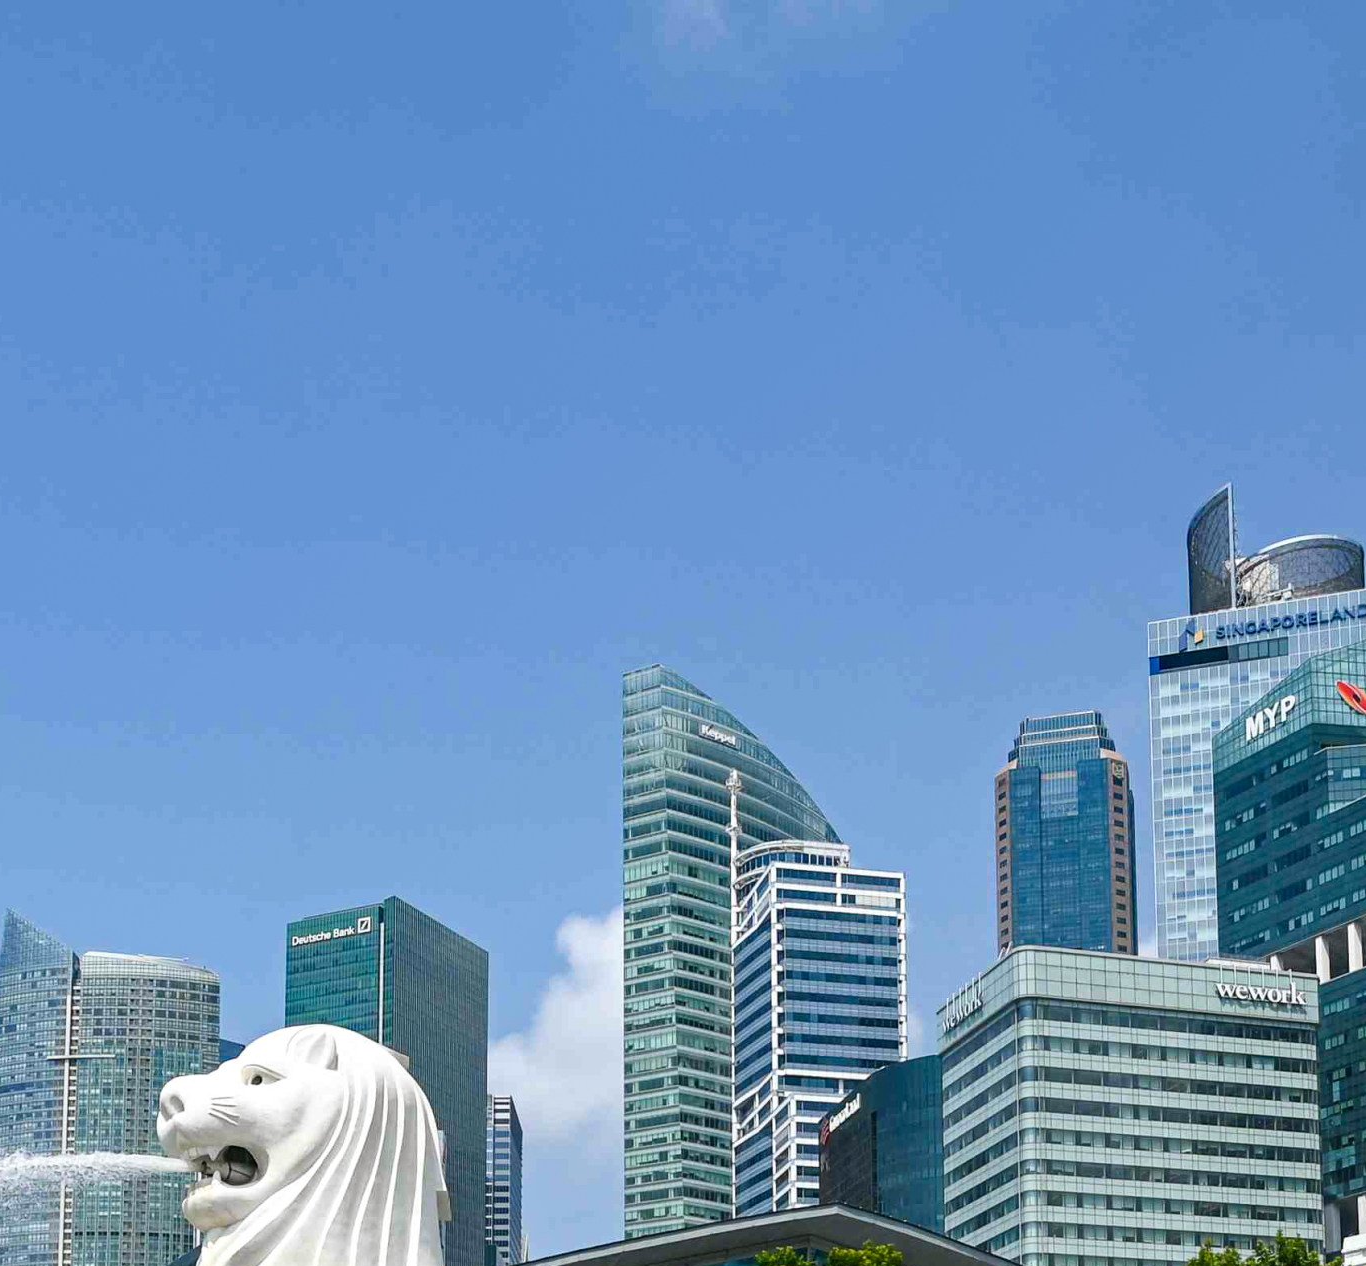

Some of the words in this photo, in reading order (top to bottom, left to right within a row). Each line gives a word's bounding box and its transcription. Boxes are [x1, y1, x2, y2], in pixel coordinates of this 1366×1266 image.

[1245, 694, 1297, 742] MYP
[292, 931, 331, 946] Deutsche
[333, 926, 355, 938] Bank
[1215, 981, 1307, 1005] wework
